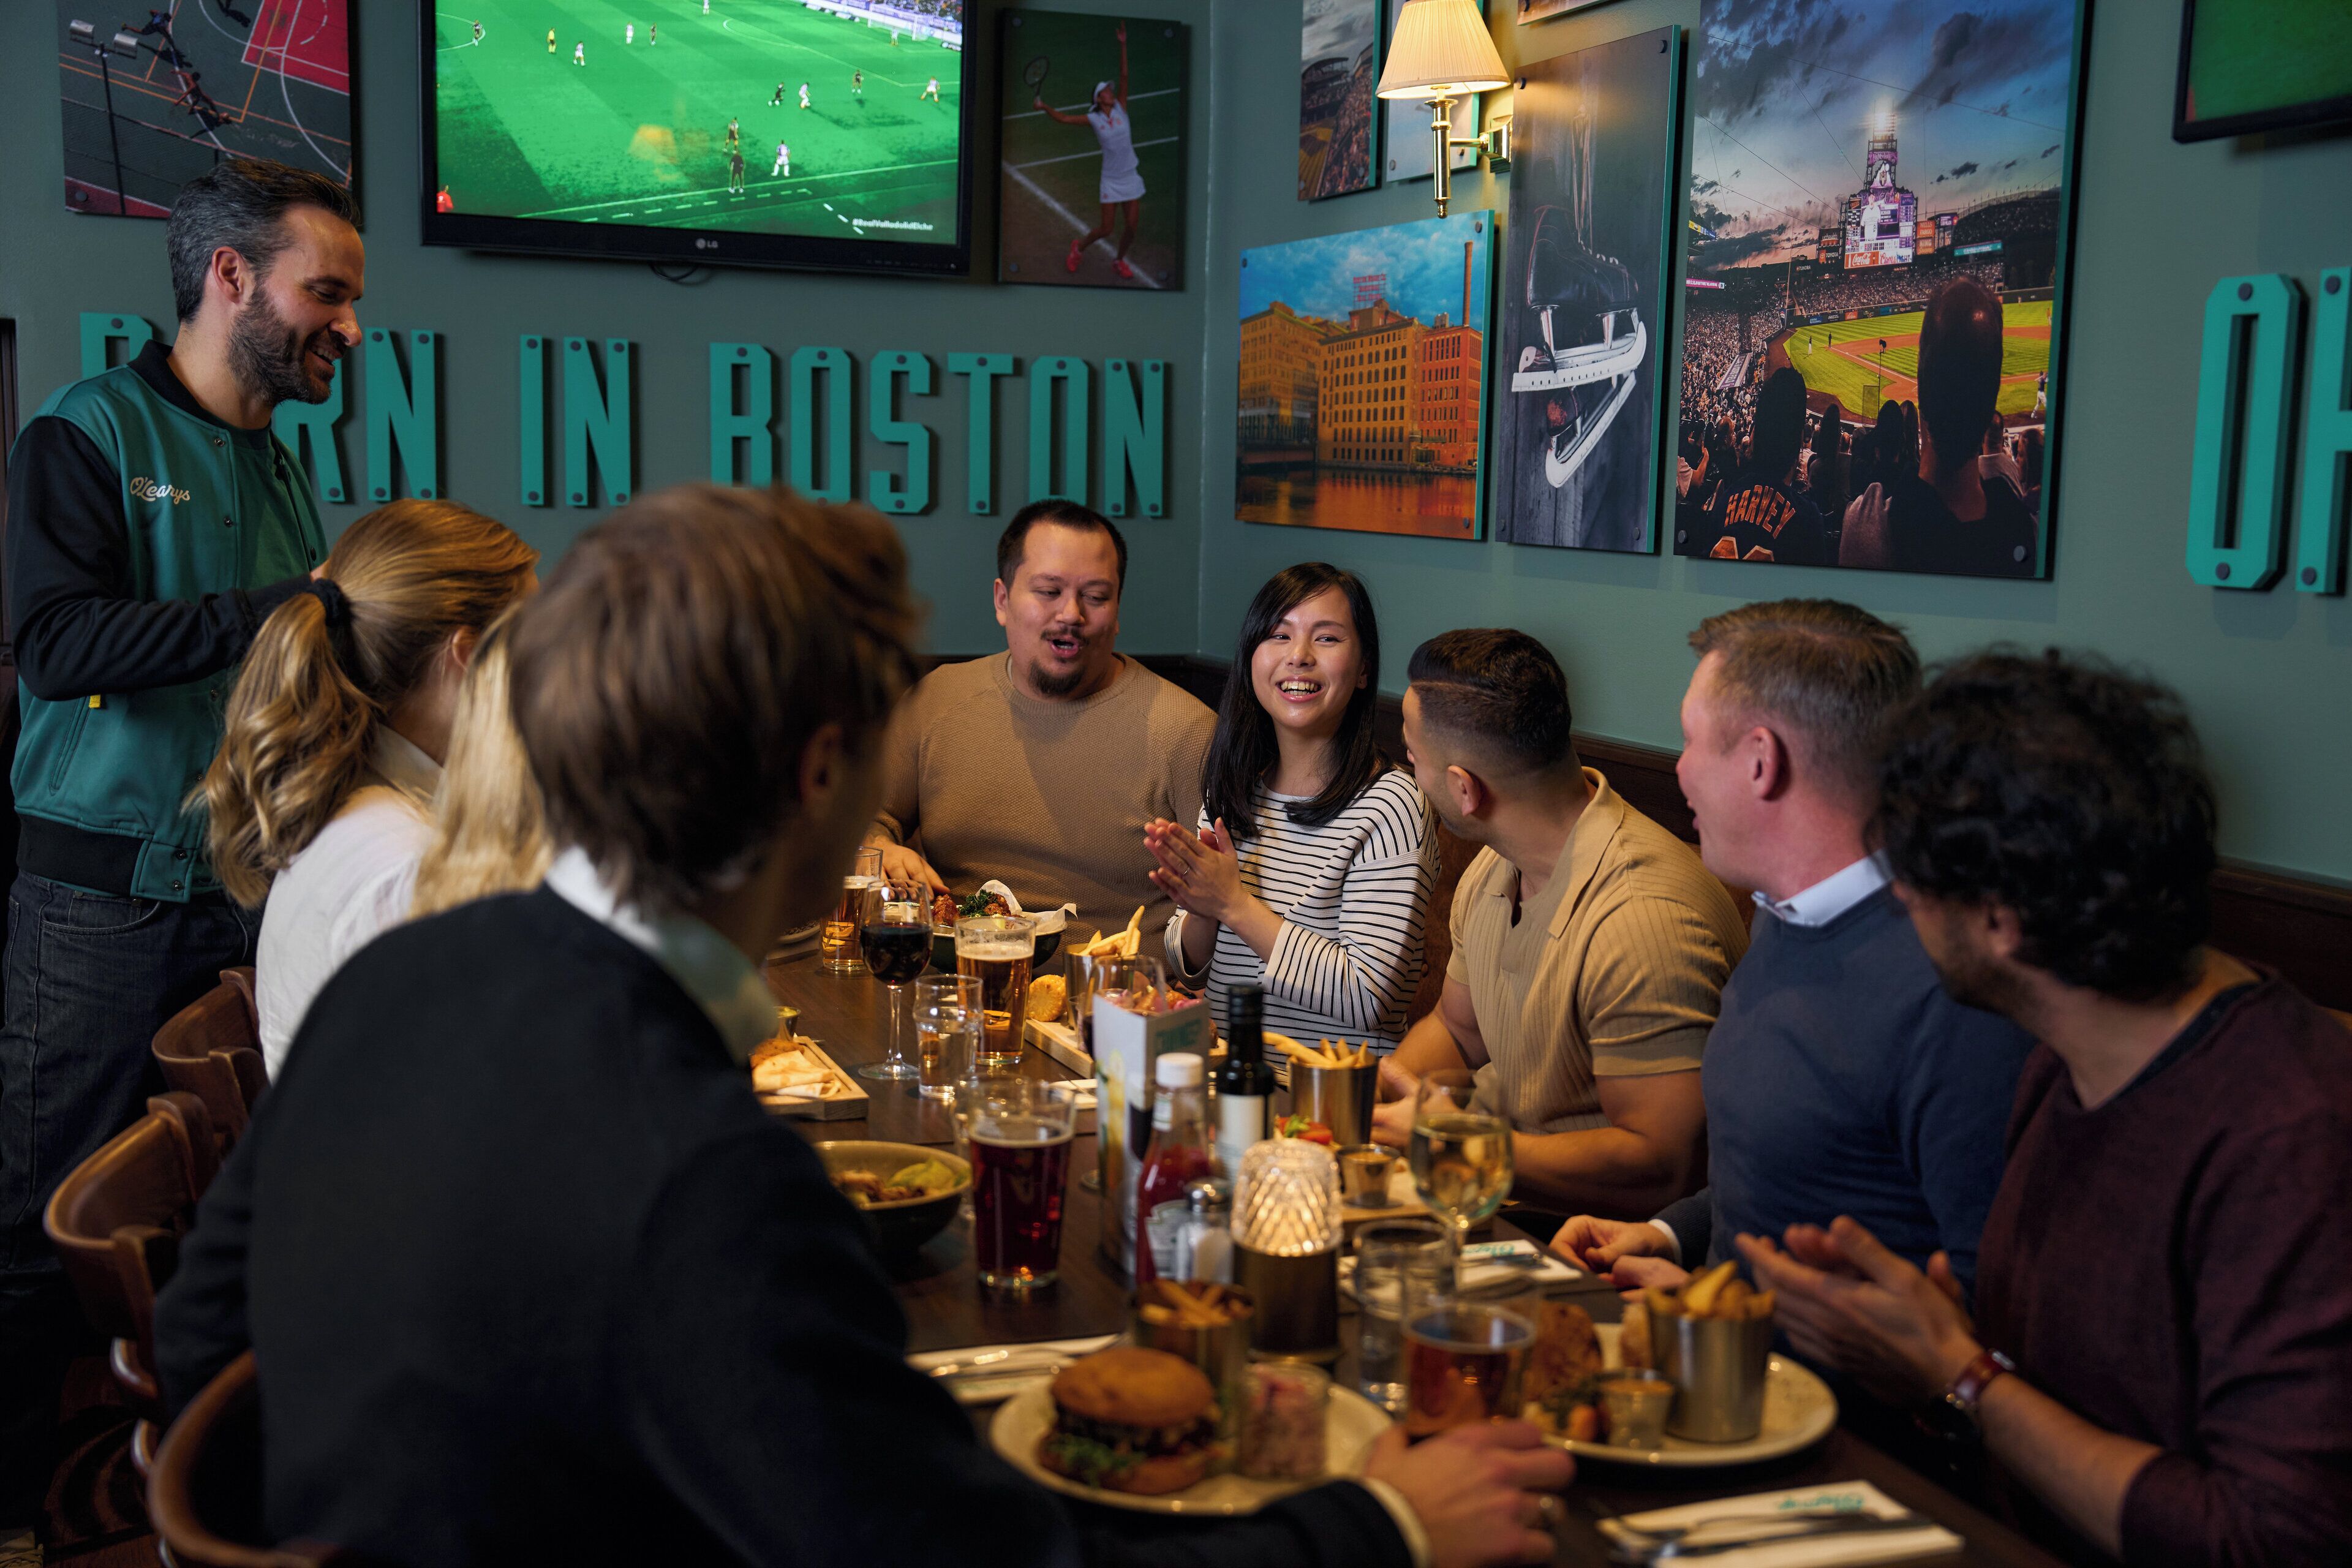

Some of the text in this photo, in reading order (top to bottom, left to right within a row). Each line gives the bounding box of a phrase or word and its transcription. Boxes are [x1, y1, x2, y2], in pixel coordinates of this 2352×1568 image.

[519, 334, 631, 506] IN
[710, 342, 1164, 516] BOSTON
[130, 477, 190, 504] O'Learys
[1724, 484, 1796, 539] HARVEY
